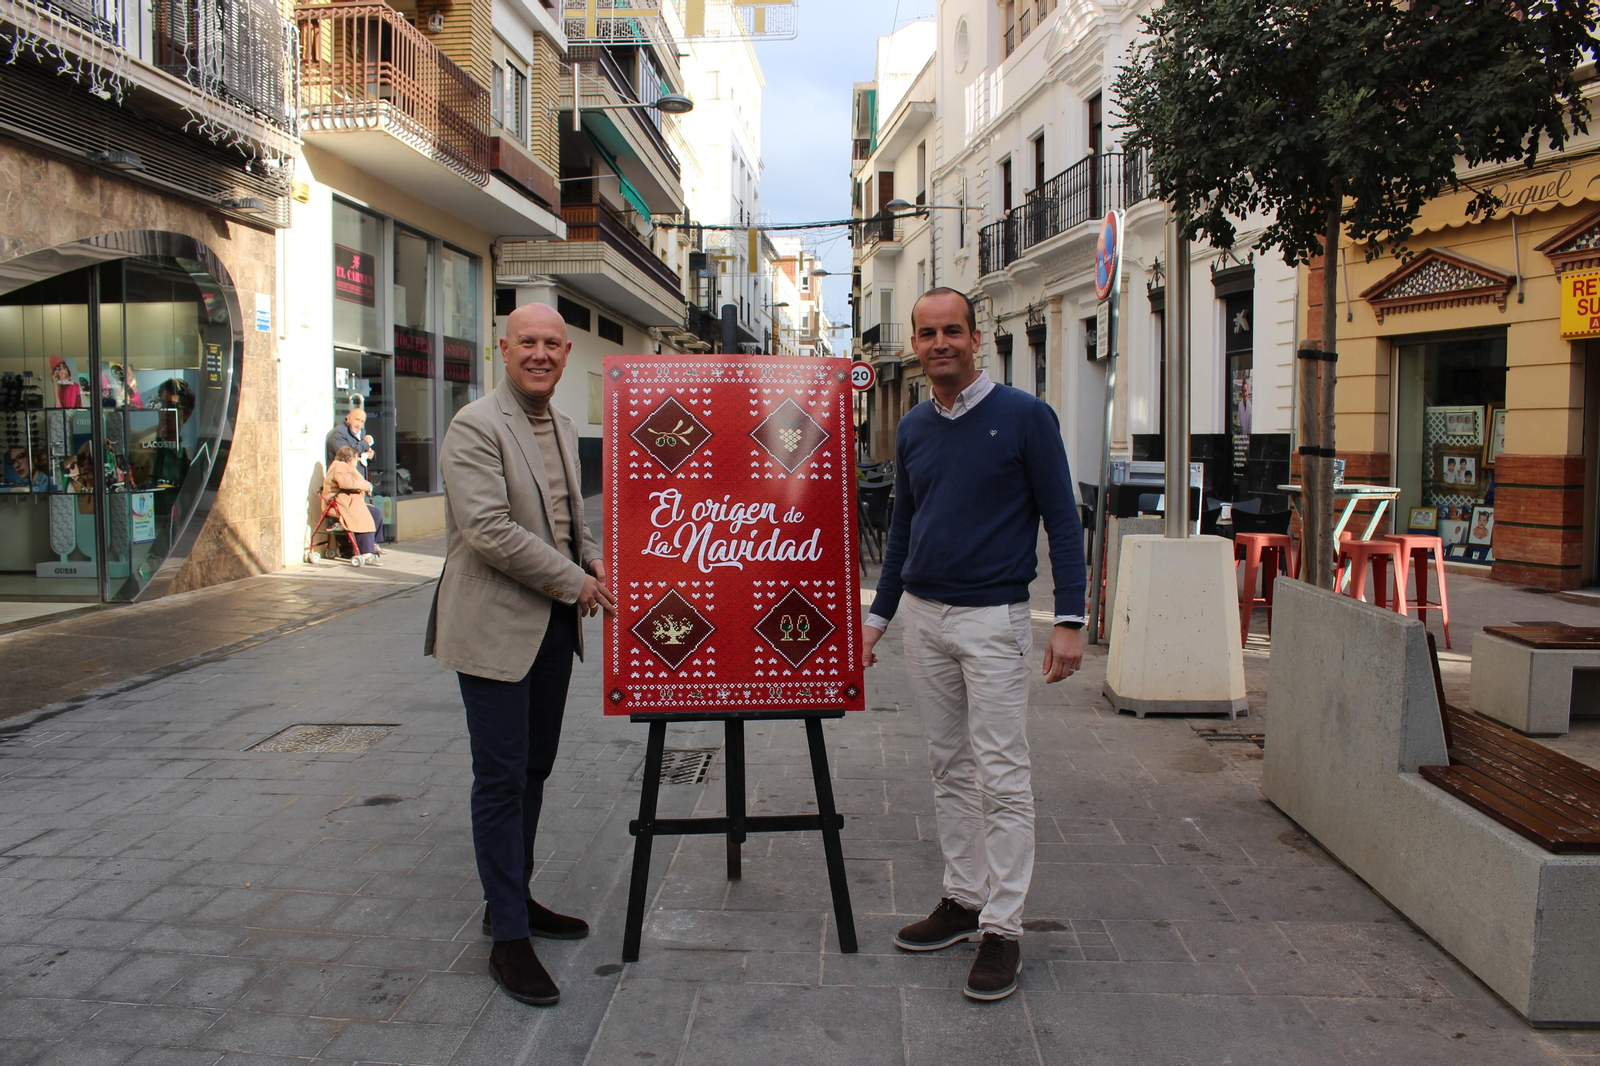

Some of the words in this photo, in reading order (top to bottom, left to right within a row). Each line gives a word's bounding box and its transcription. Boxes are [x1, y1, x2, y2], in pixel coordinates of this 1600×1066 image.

[336, 265, 346, 279] EL
[346, 269, 374, 287] CARMEN
[1572, 277, 1600, 298] RE
[852, 371, 869, 381] 20
[142, 441, 176, 449] LACOSTE
[648, 488, 685, 528] El
[691, 494, 779, 534] origen
[783, 506, 804, 523] de
[641, 531, 680, 558] La
[673, 521, 823, 574] Navidad
[54, 567, 77, 575] GUESS
